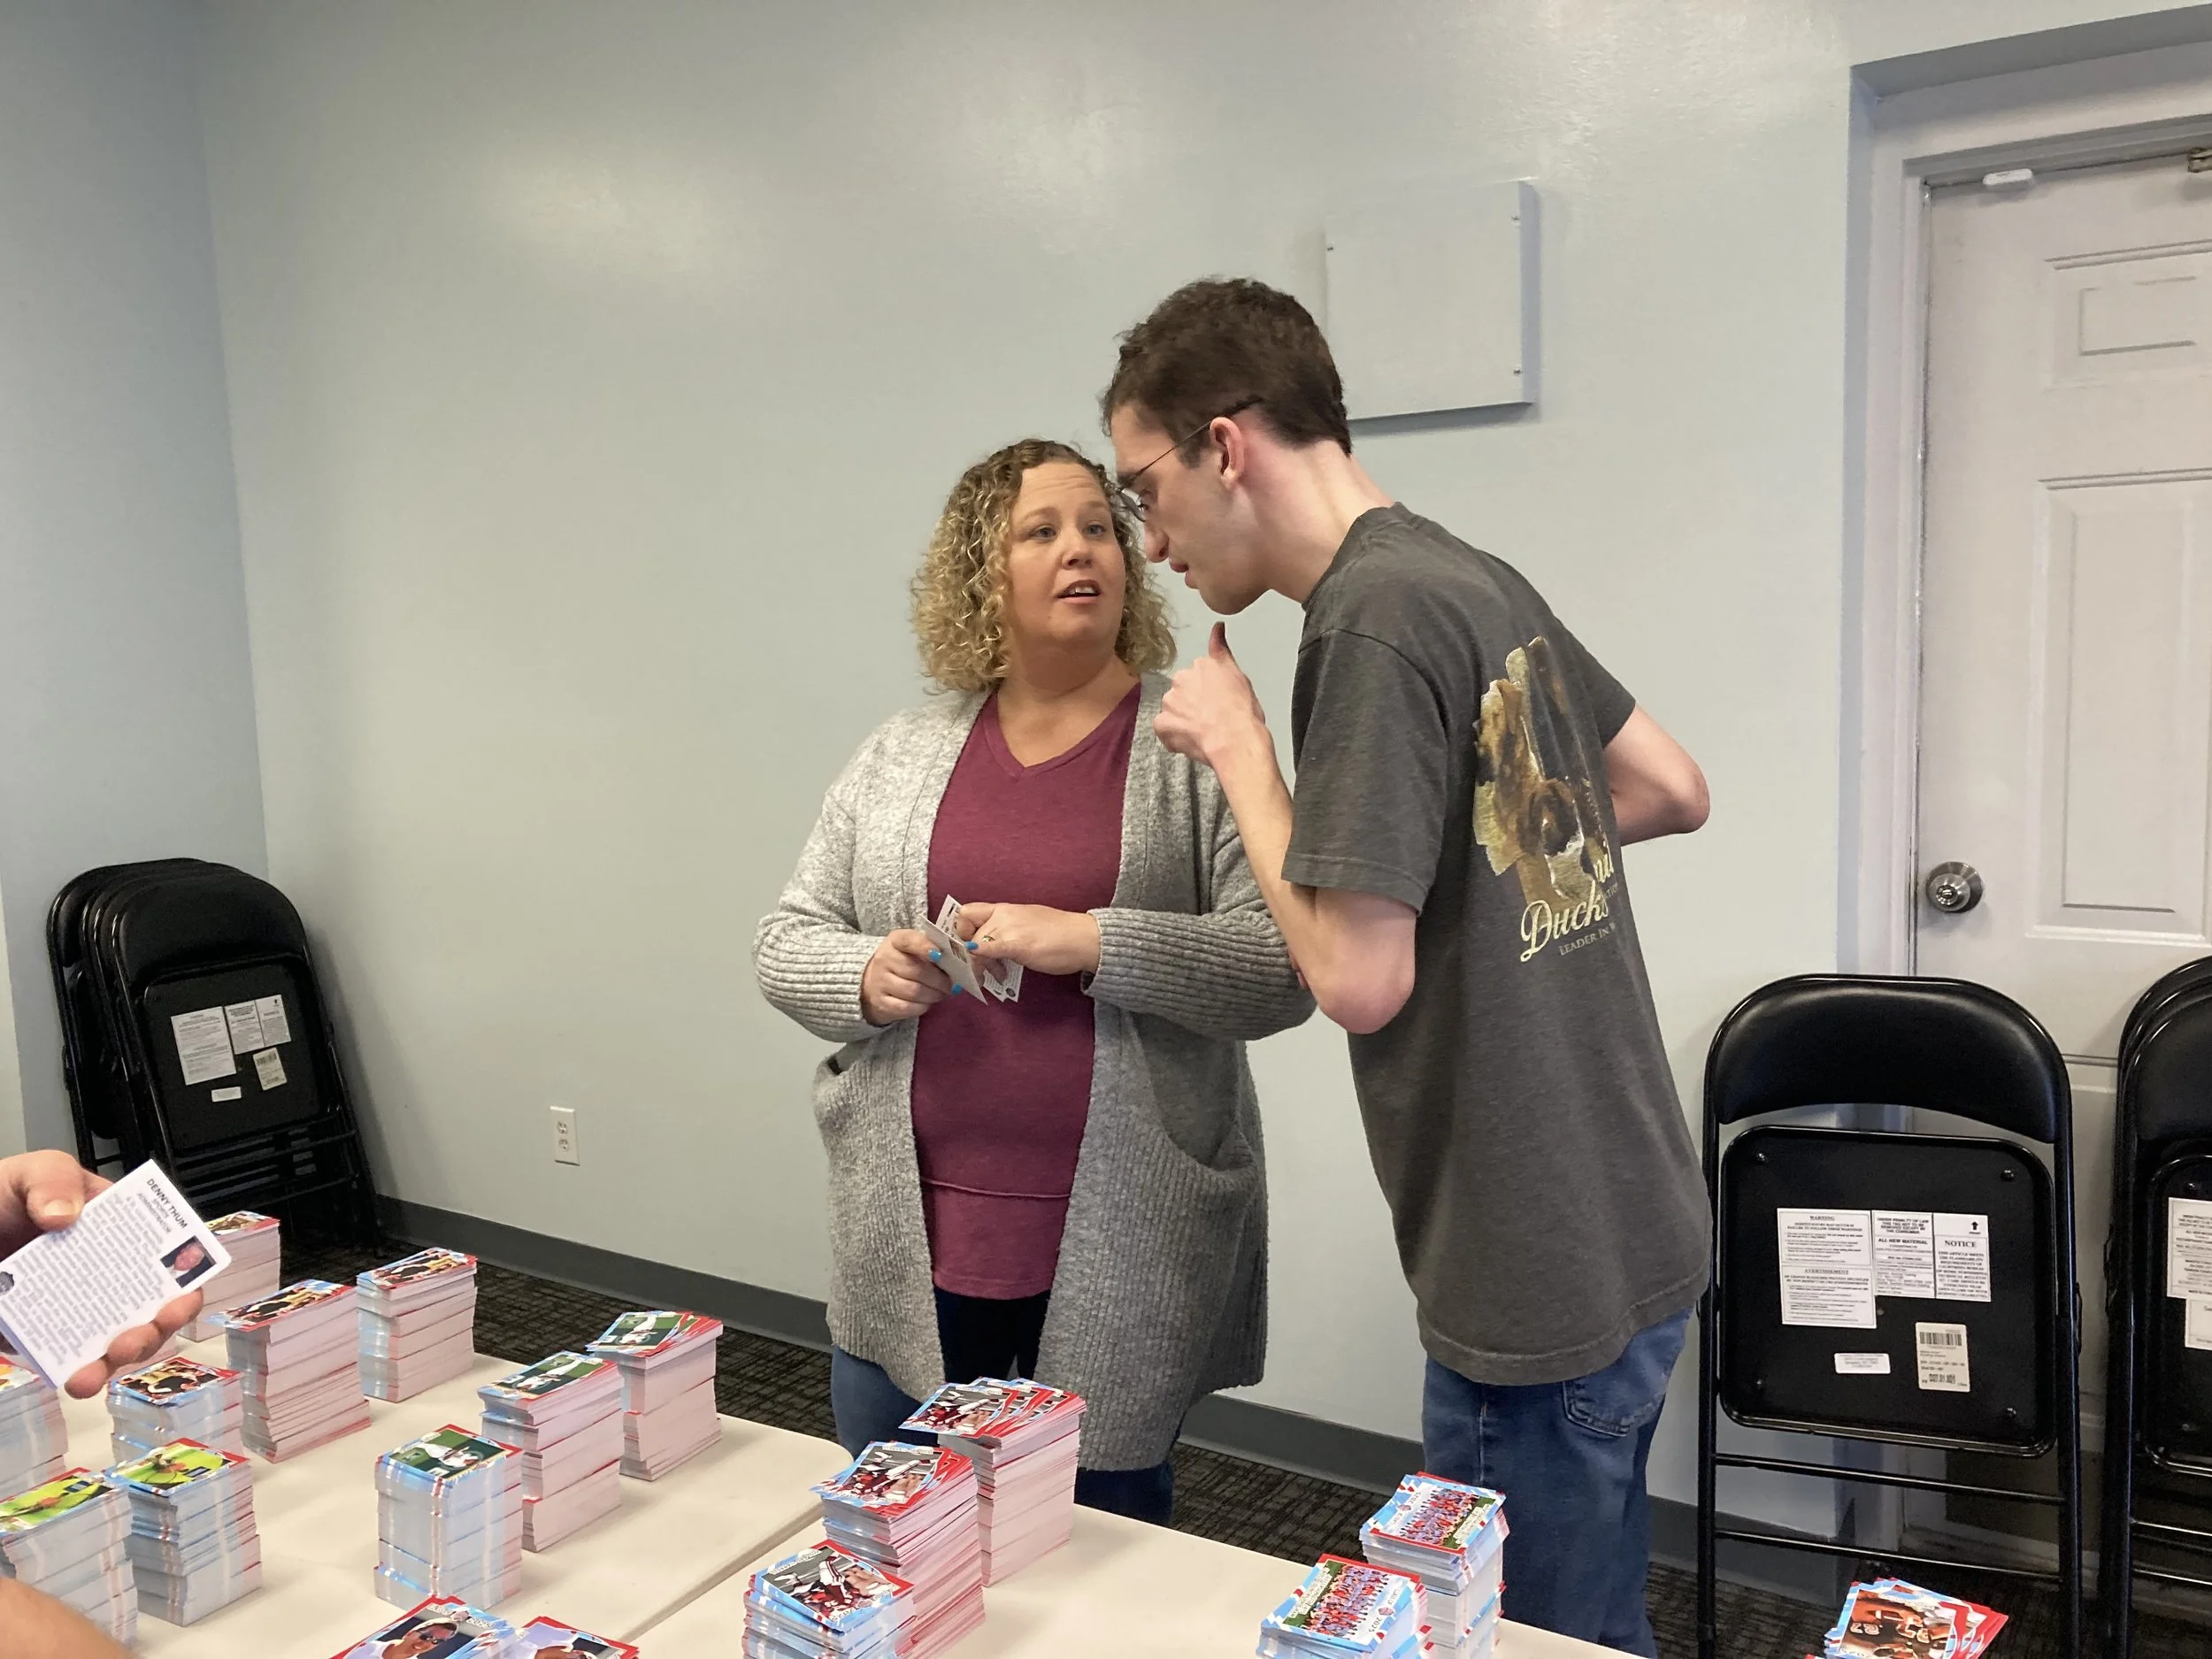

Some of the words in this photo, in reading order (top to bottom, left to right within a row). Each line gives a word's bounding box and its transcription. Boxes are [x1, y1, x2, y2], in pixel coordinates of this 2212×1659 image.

[1559, 933, 1598, 956] LEADER
[147, 1179, 171, 1205] DENNY
[169, 1205, 188, 1228] THUM
[1368, 1617, 1382, 1632] 2025
